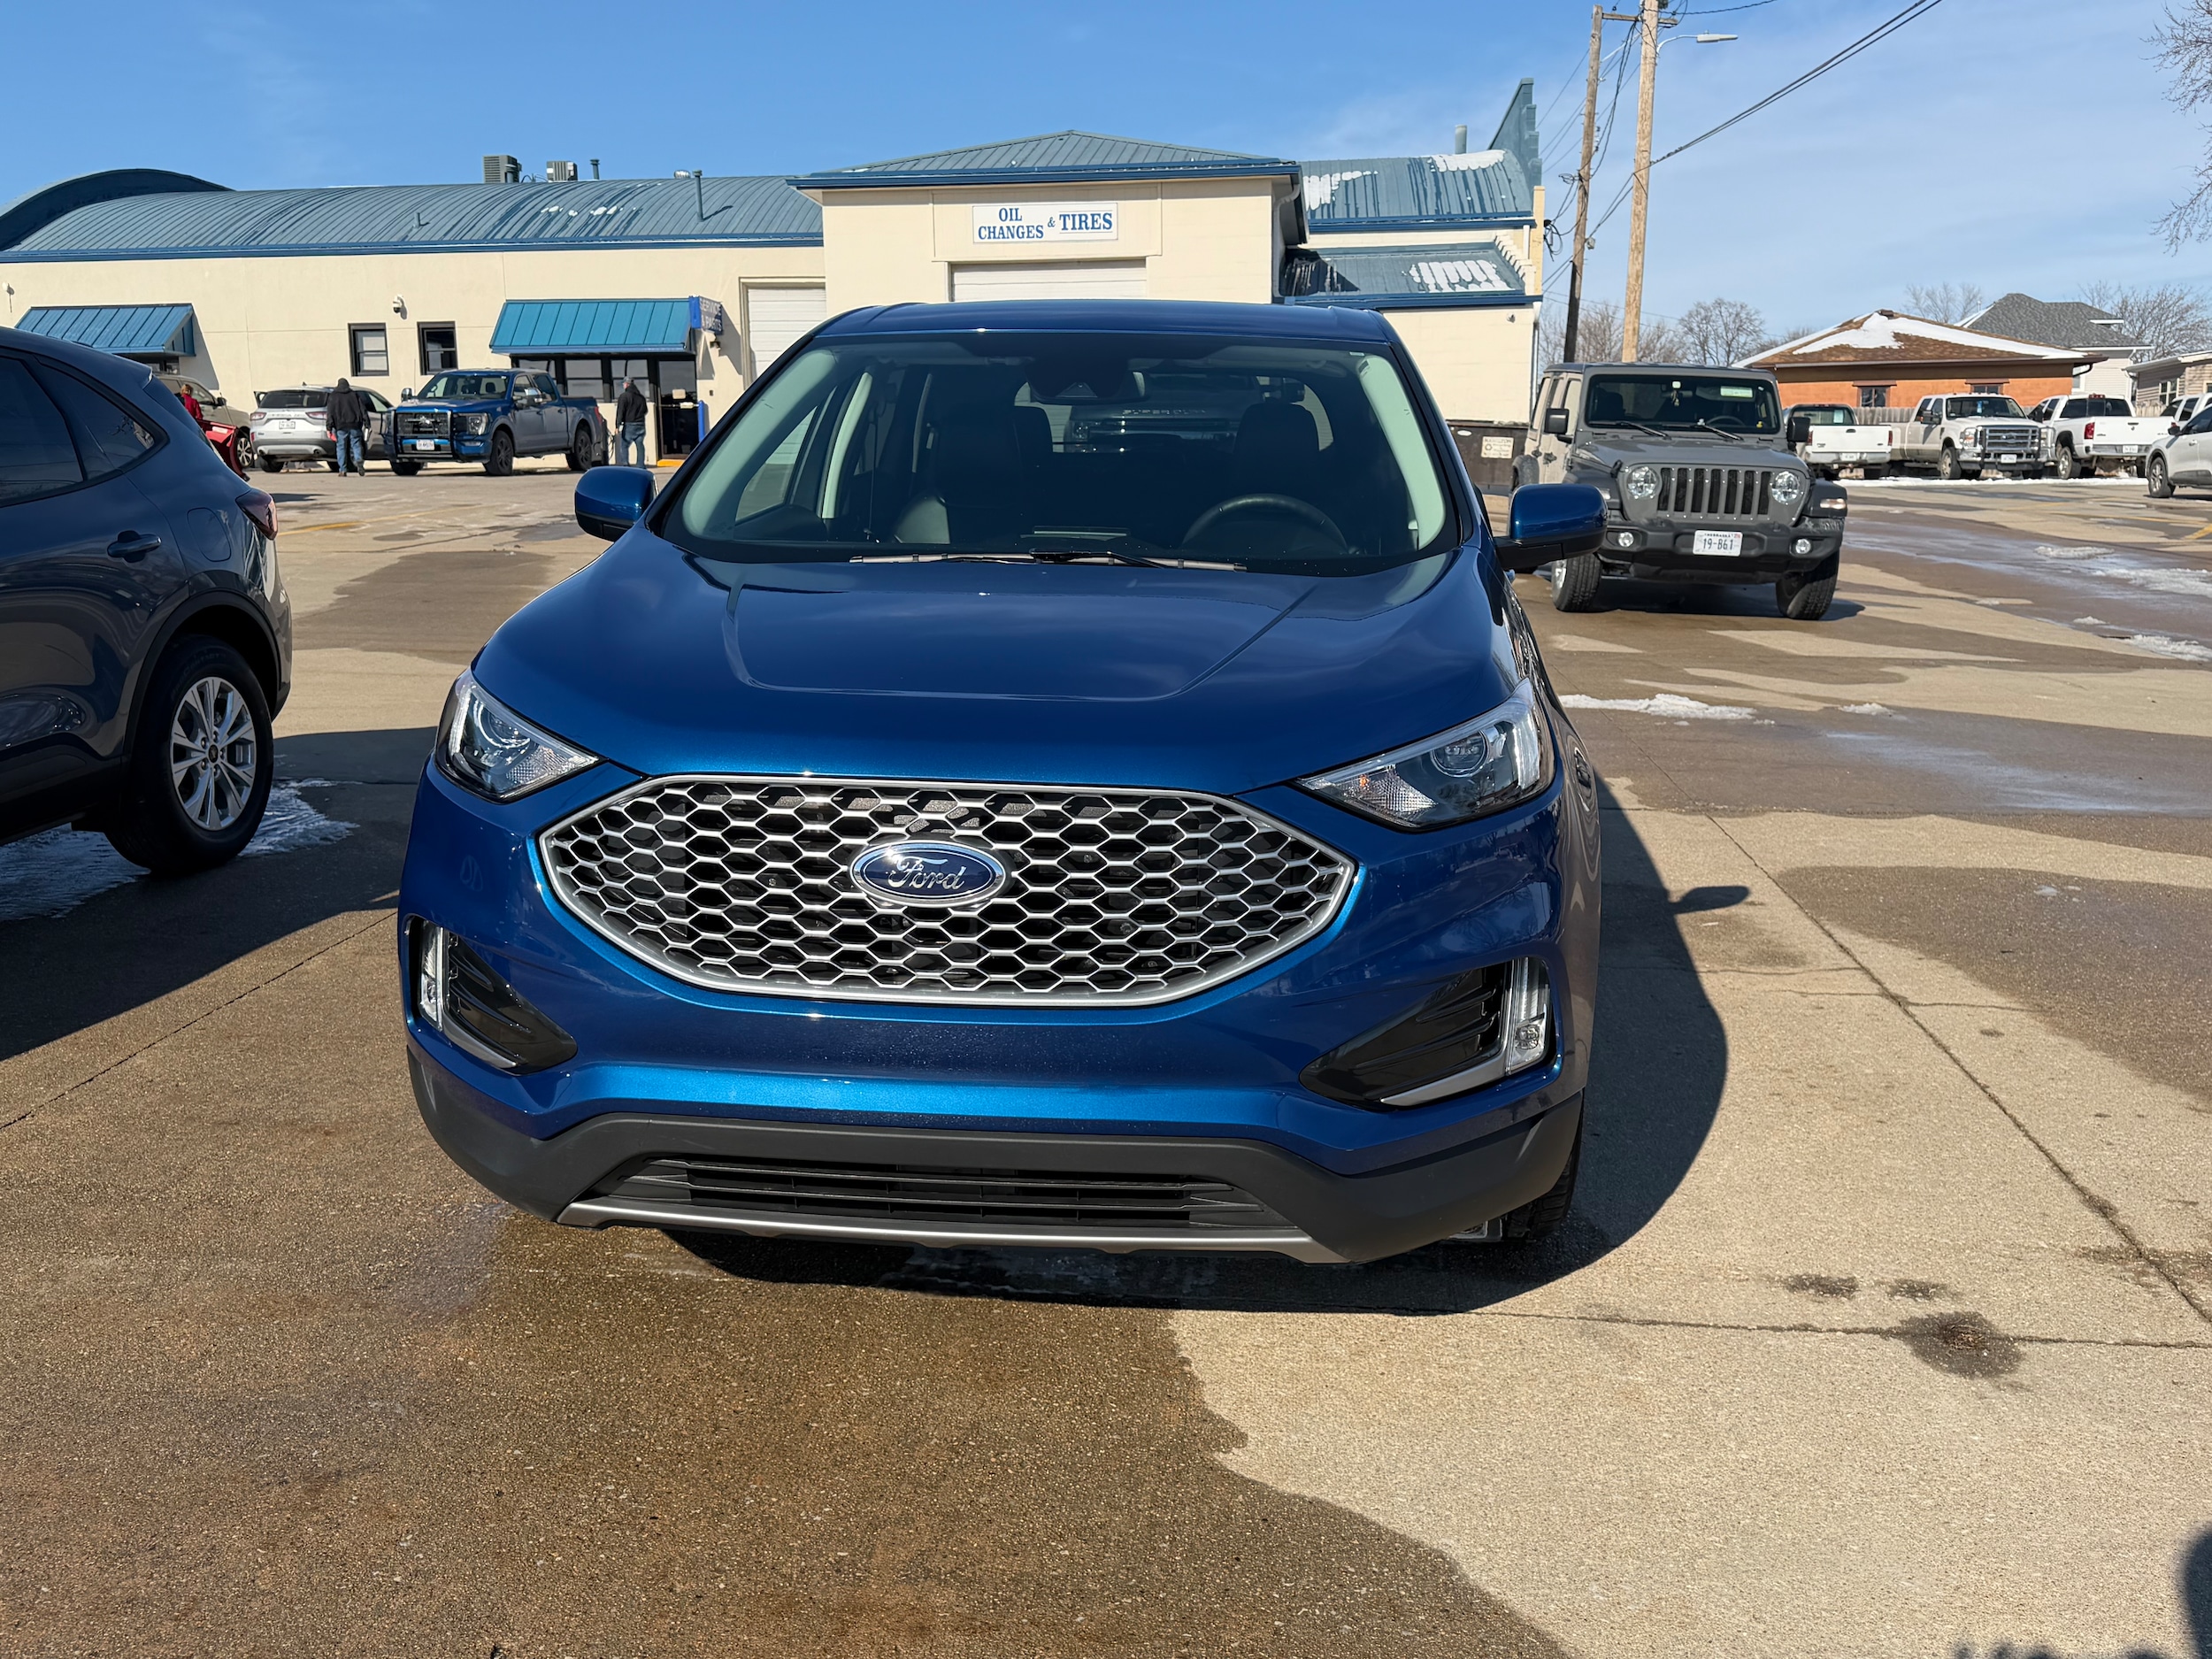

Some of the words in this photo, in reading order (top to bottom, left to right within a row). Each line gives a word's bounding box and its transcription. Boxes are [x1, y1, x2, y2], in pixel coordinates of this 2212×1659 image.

[998, 207, 1023, 222] OIL
[978, 225, 1044, 240] CHANGES
[1048, 216, 1056, 227] &
[1059, 212, 1113, 231] TIRES
[699, 296, 722, 316] SERVICE
[705, 315, 723, 332] PARTS
[886, 856, 967, 890] Ford
